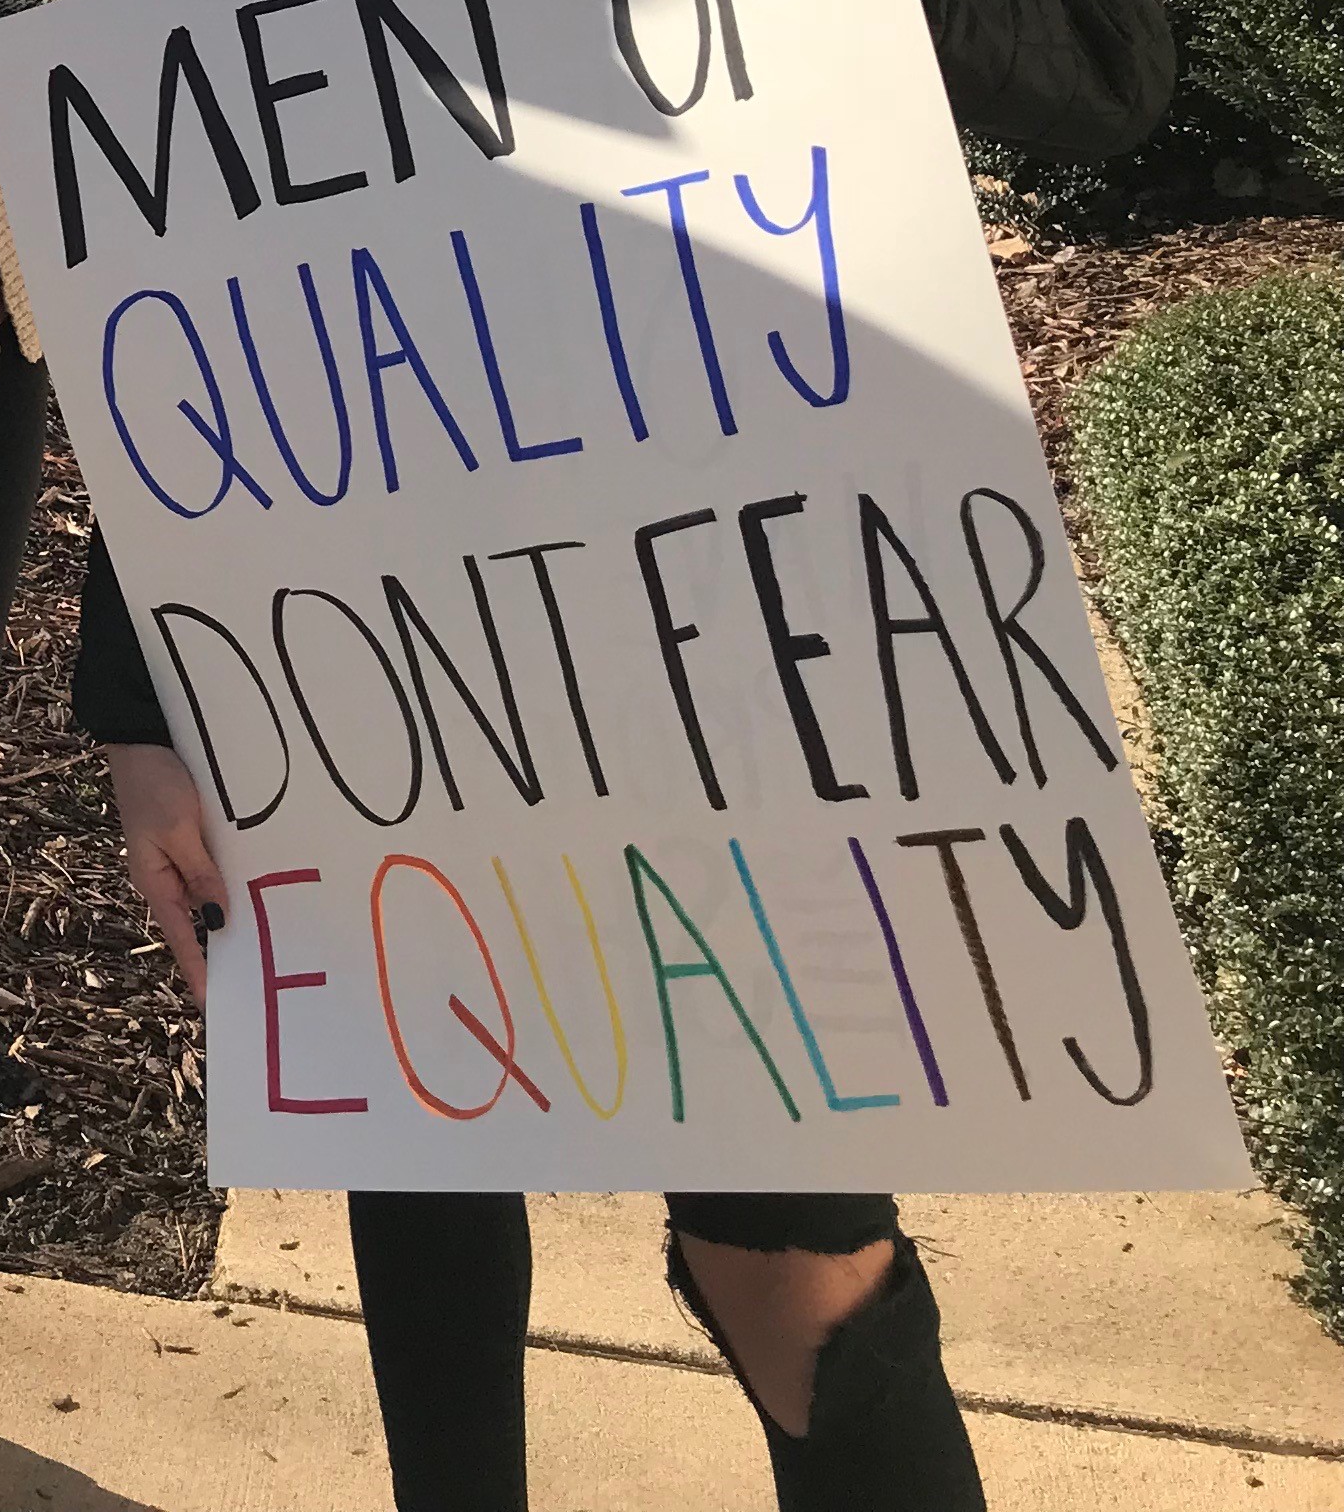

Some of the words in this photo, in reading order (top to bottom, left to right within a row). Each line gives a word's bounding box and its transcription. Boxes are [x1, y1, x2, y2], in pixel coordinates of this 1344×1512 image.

[101, 145, 850, 520] QUALITY
[150, 541, 610, 829] DONT
[635, 487, 1119, 812] FEAR
[246, 815, 1154, 1124] EQUALITY
